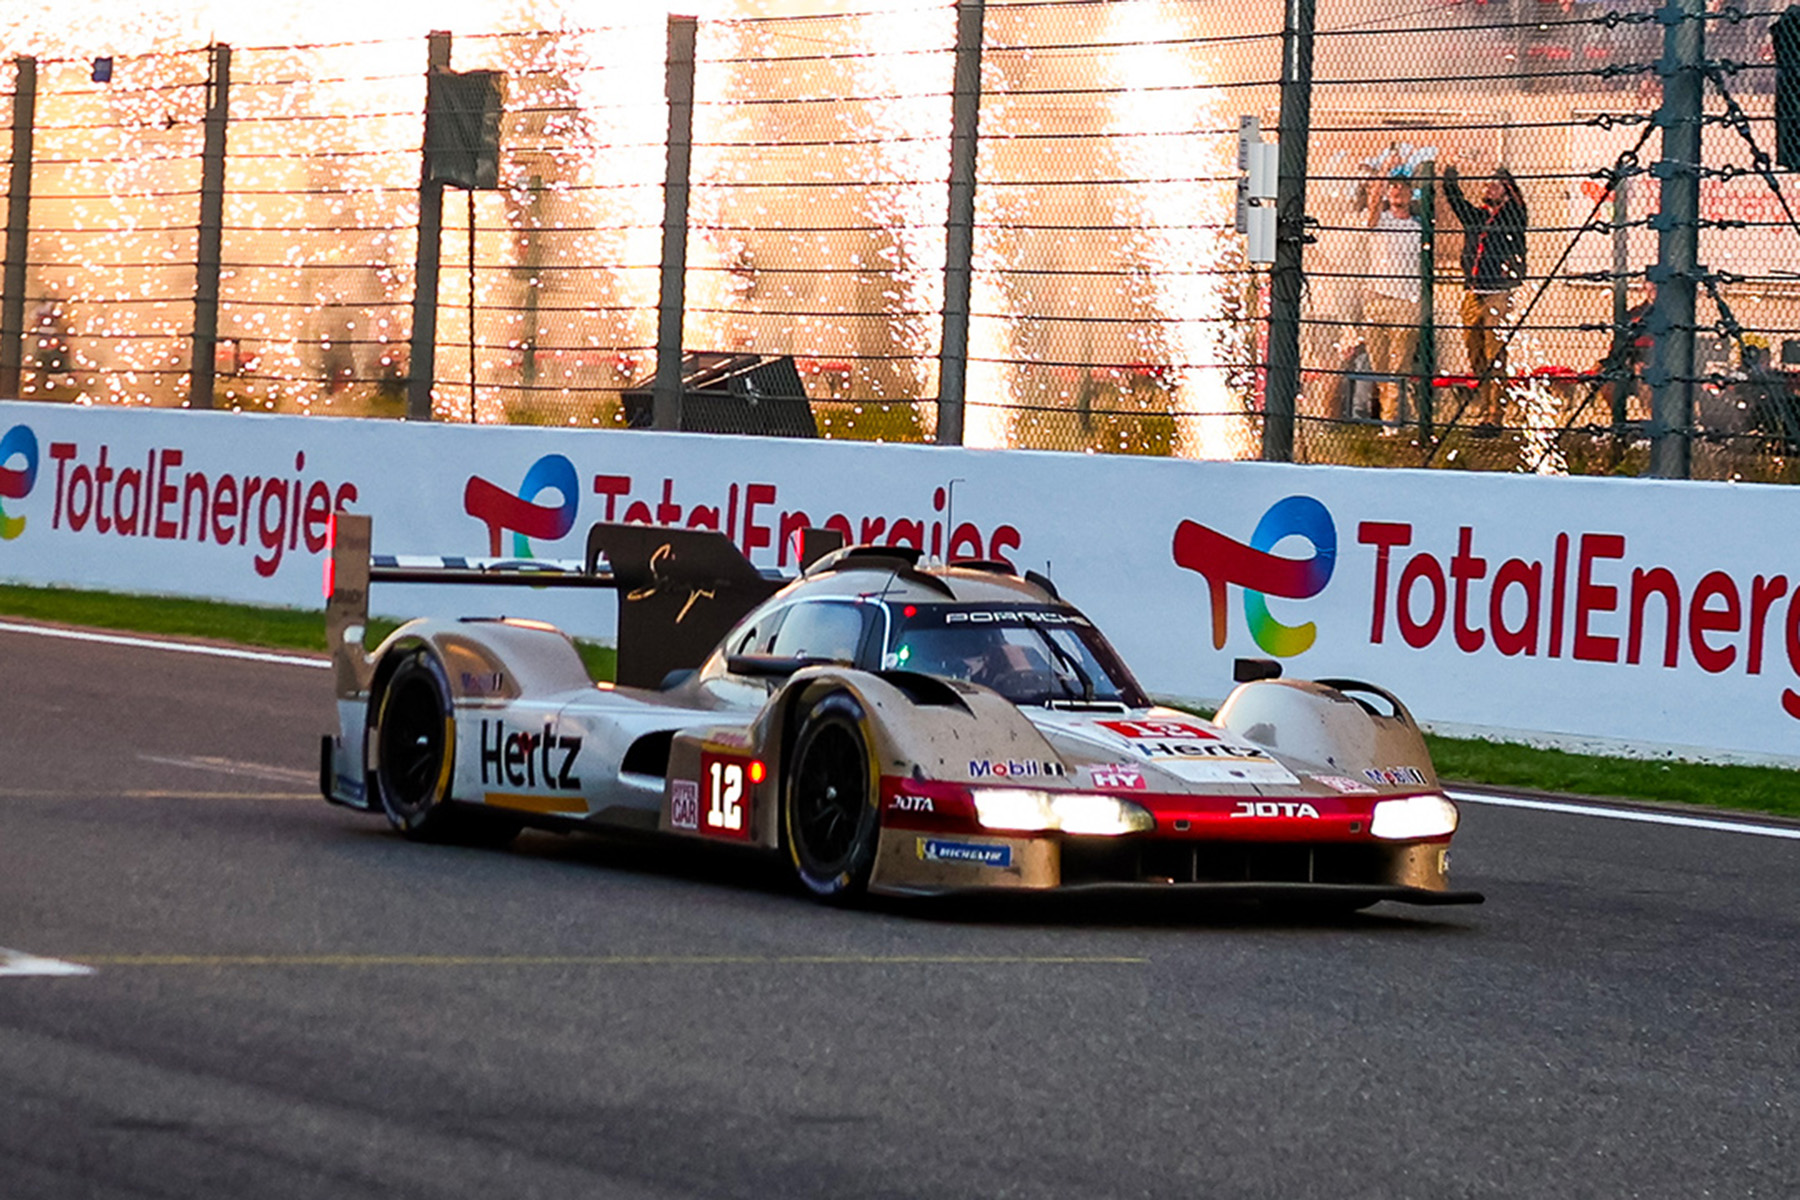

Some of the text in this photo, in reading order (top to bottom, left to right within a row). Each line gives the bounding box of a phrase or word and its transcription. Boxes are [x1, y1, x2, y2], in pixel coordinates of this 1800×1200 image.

[1119, 722, 1199, 738] 12
[480, 719, 583, 790] Hertz
[1136, 742, 1273, 760] Hertz
[969, 759, 1038, 778] Mobil
[707, 761, 743, 830] 12
[889, 795, 934, 812] JOTA
[673, 798, 697, 825] CAR
[1229, 801, 1320, 819] JOTA
